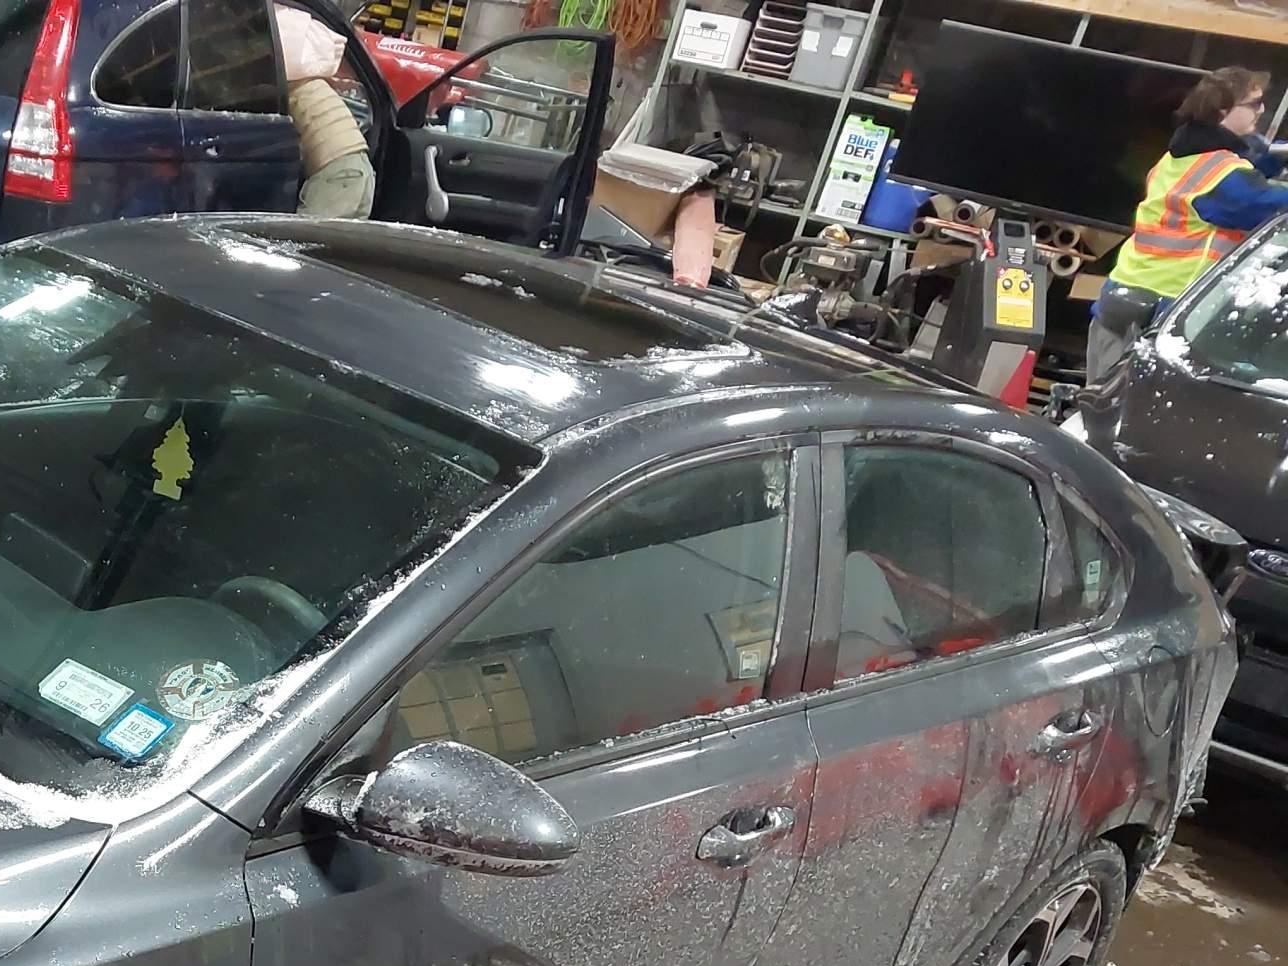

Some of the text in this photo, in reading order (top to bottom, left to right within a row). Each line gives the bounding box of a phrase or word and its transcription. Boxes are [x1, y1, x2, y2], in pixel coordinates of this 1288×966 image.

[843, 144, 875, 159] DEF
[55, 680, 68, 691] 9
[89, 698, 111, 713] 26
